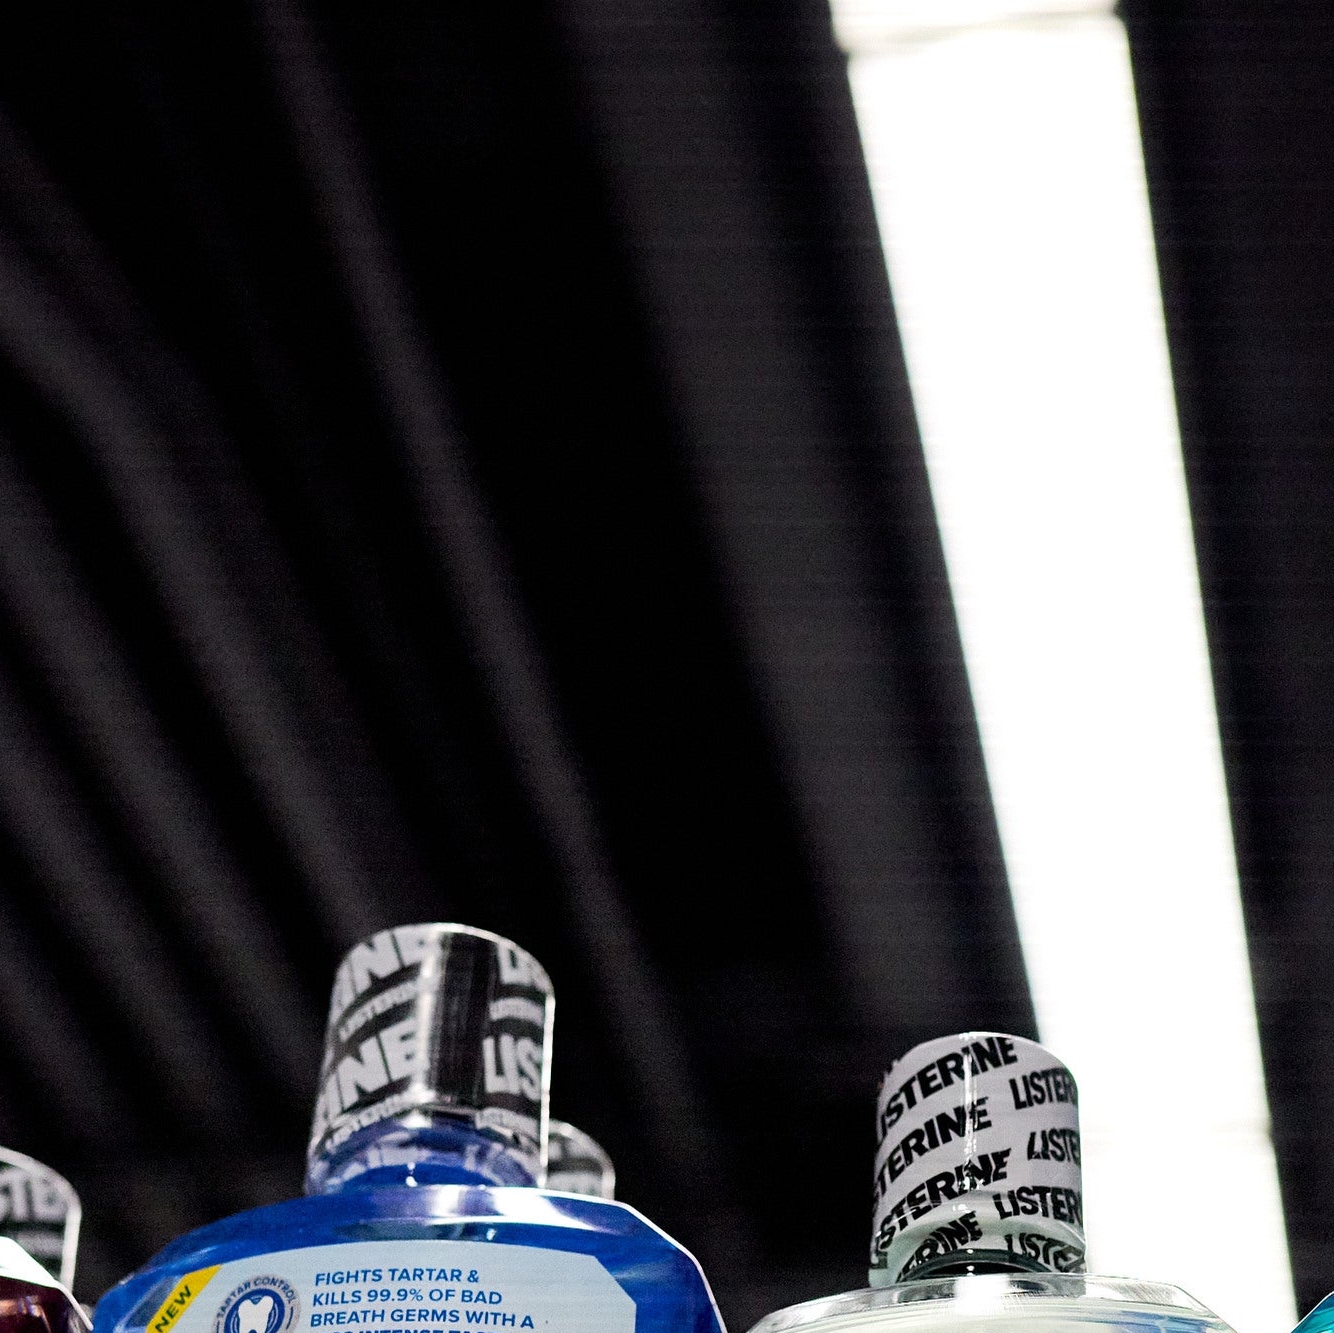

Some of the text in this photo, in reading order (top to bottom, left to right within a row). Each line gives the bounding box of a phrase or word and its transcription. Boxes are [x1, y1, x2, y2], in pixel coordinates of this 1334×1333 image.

[315, 1268, 479, 1286] FIGHTS TARTAR &
[217, 1277, 296, 1318] TARTAR CONTROL
[313, 1288, 503, 1307] KILLS 99.9% OF BAD
[155, 1285, 192, 1333] NEW
[310, 1308, 534, 1328] BREATH GERMS WITH A
